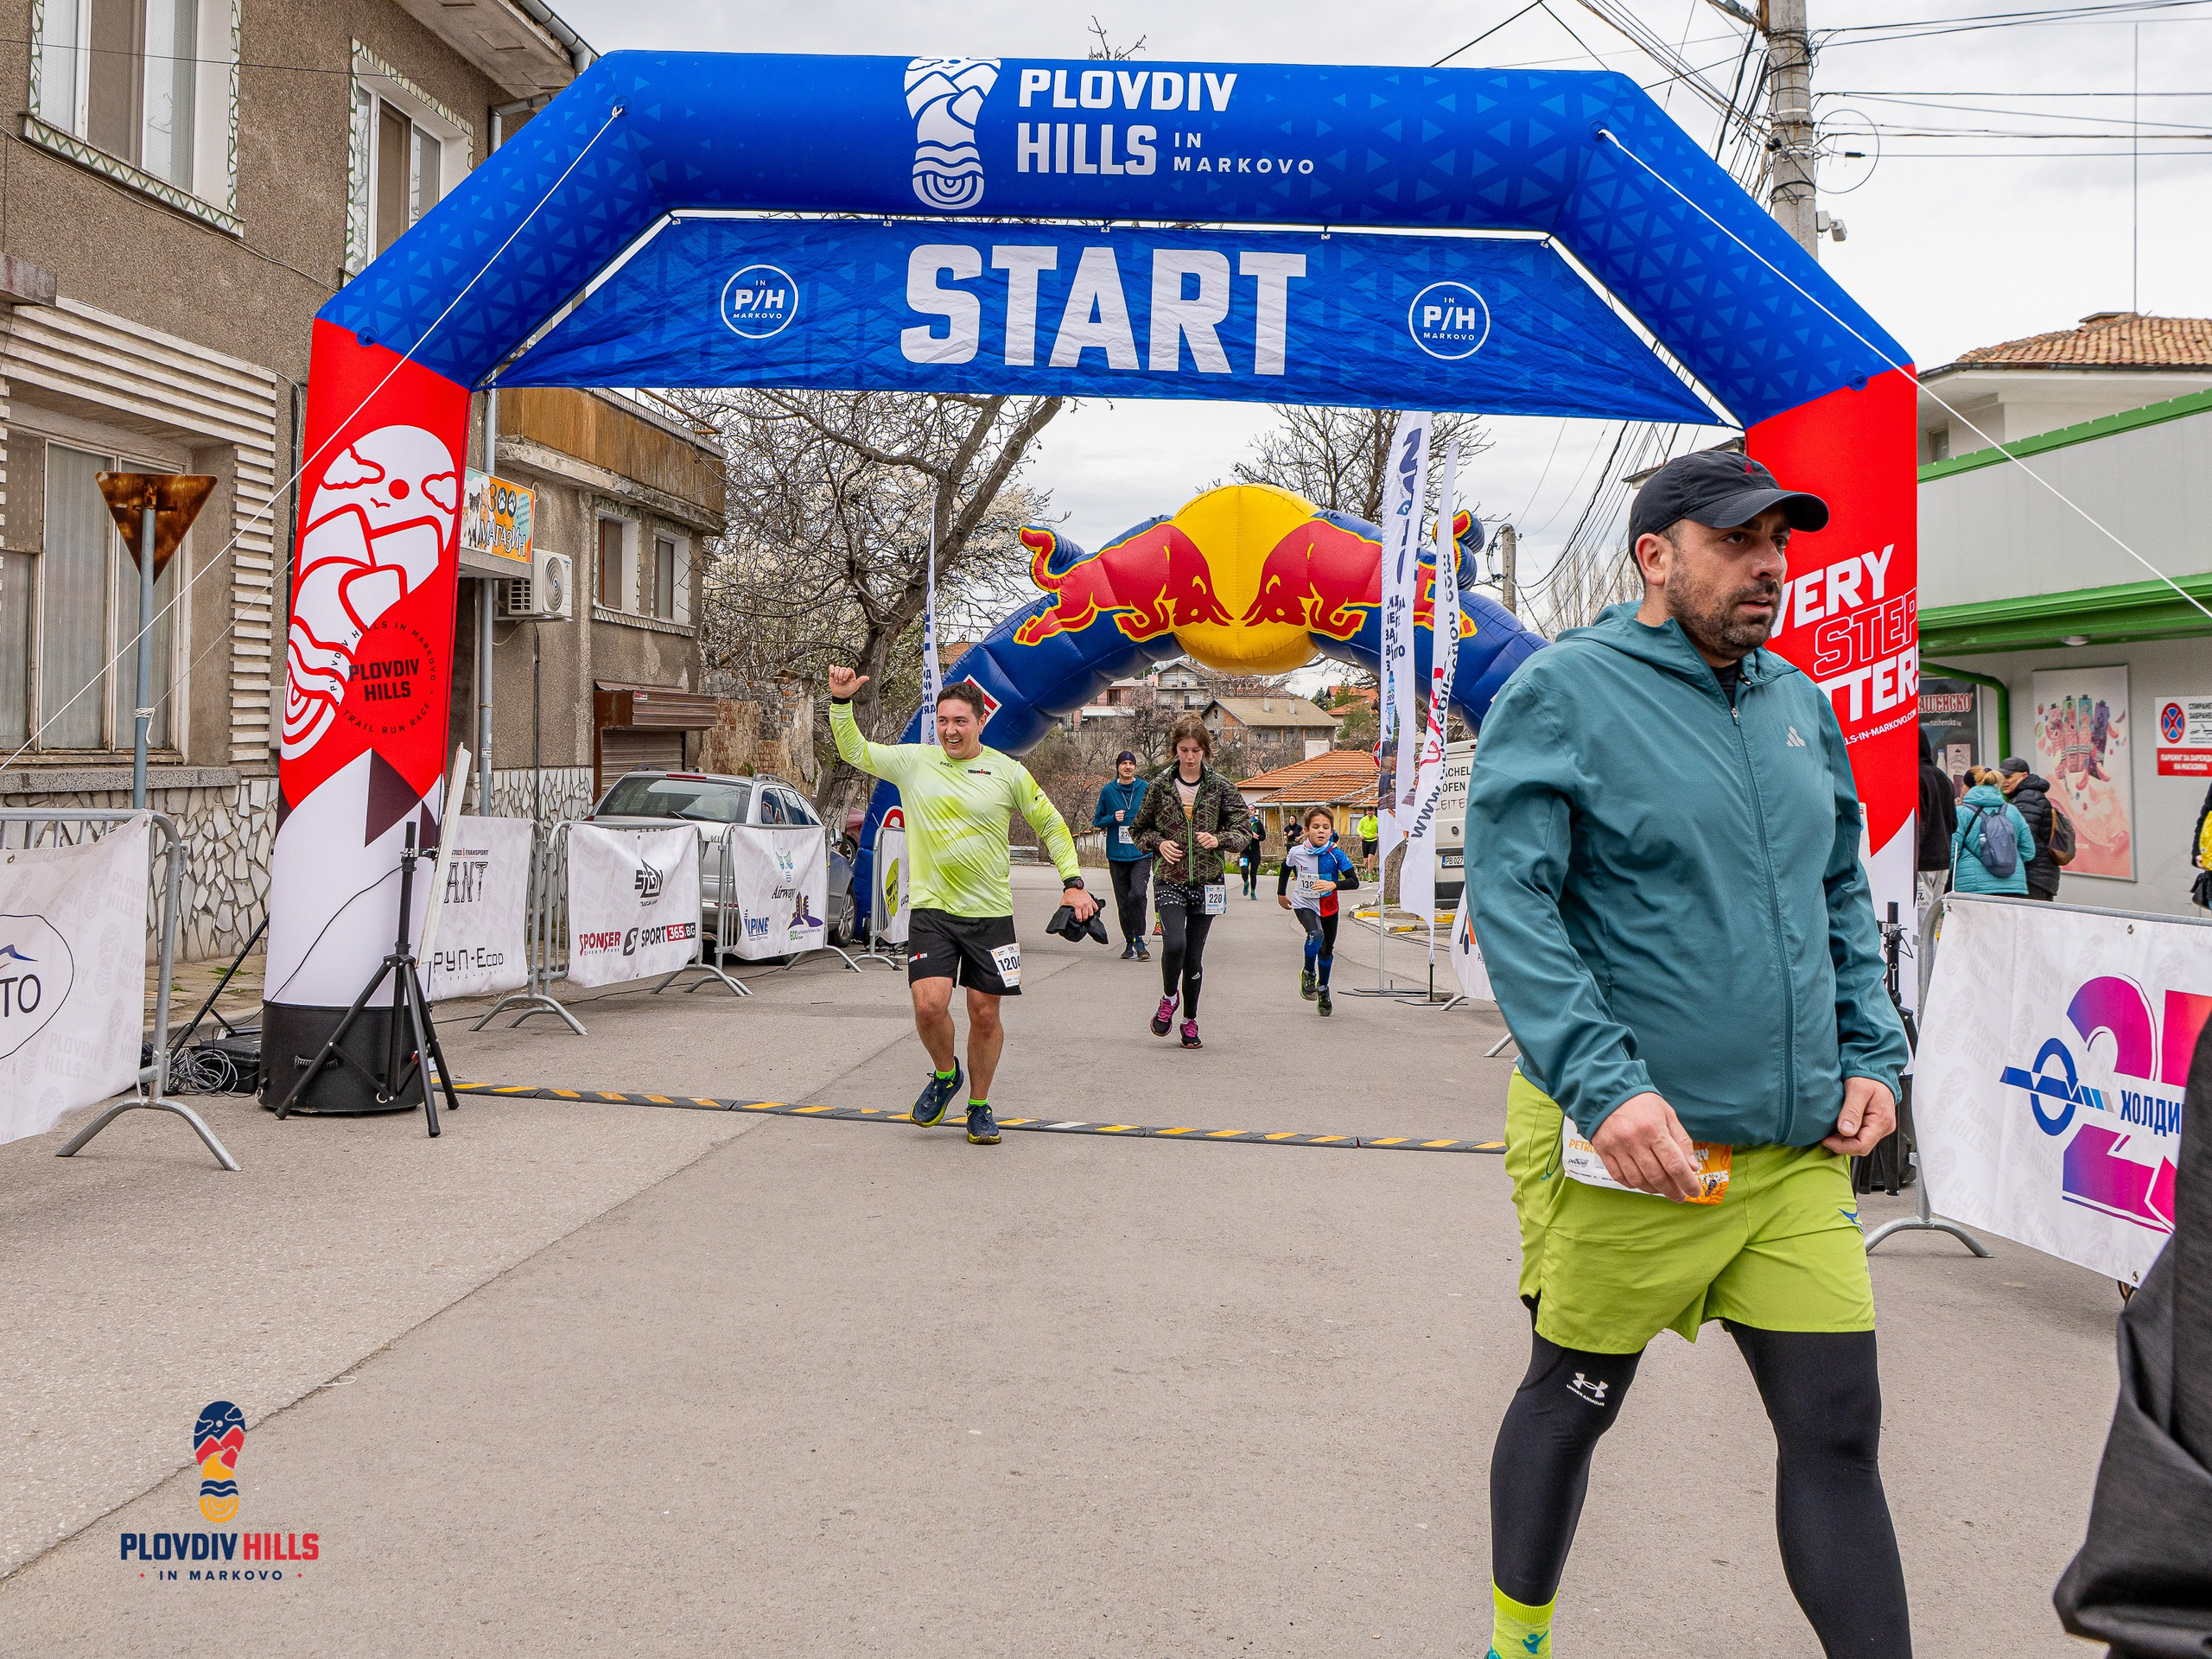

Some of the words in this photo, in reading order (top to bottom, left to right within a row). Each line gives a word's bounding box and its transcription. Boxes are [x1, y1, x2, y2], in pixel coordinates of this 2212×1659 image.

[1019, 68, 1238, 112] PLOVDIV
[1017, 123, 1157, 175] HILLS
[1173, 132, 1201, 149] IN
[1173, 156, 1314, 175] MARKOVO
[734, 289, 785, 311] P/H
[900, 244, 1306, 376] START
[1423, 306, 1475, 331] P/H
[479, 519, 526, 557] МАГАЗИН
[1814, 587, 1917, 677] STEP
[329, 639, 349, 692] PLOVDIV
[352, 621, 387, 639] HILLS
[395, 622, 406, 631] IN
[411, 630, 435, 681] MARKOVO
[348, 658, 419, 682] PLOVDIV
[364, 681, 411, 702] HILLS
[343, 709, 373, 733] TRAIL
[382, 726, 405, 734] RUN
[410, 702, 430, 727] RACE
[772, 886, 796, 901] Airway
[1209, 893, 1222, 904] 220
[579, 931, 621, 957] SPONSER
[1567, 1383, 1583, 1396] UNDER
[1582, 1395, 1605, 1407] ARMOUR
